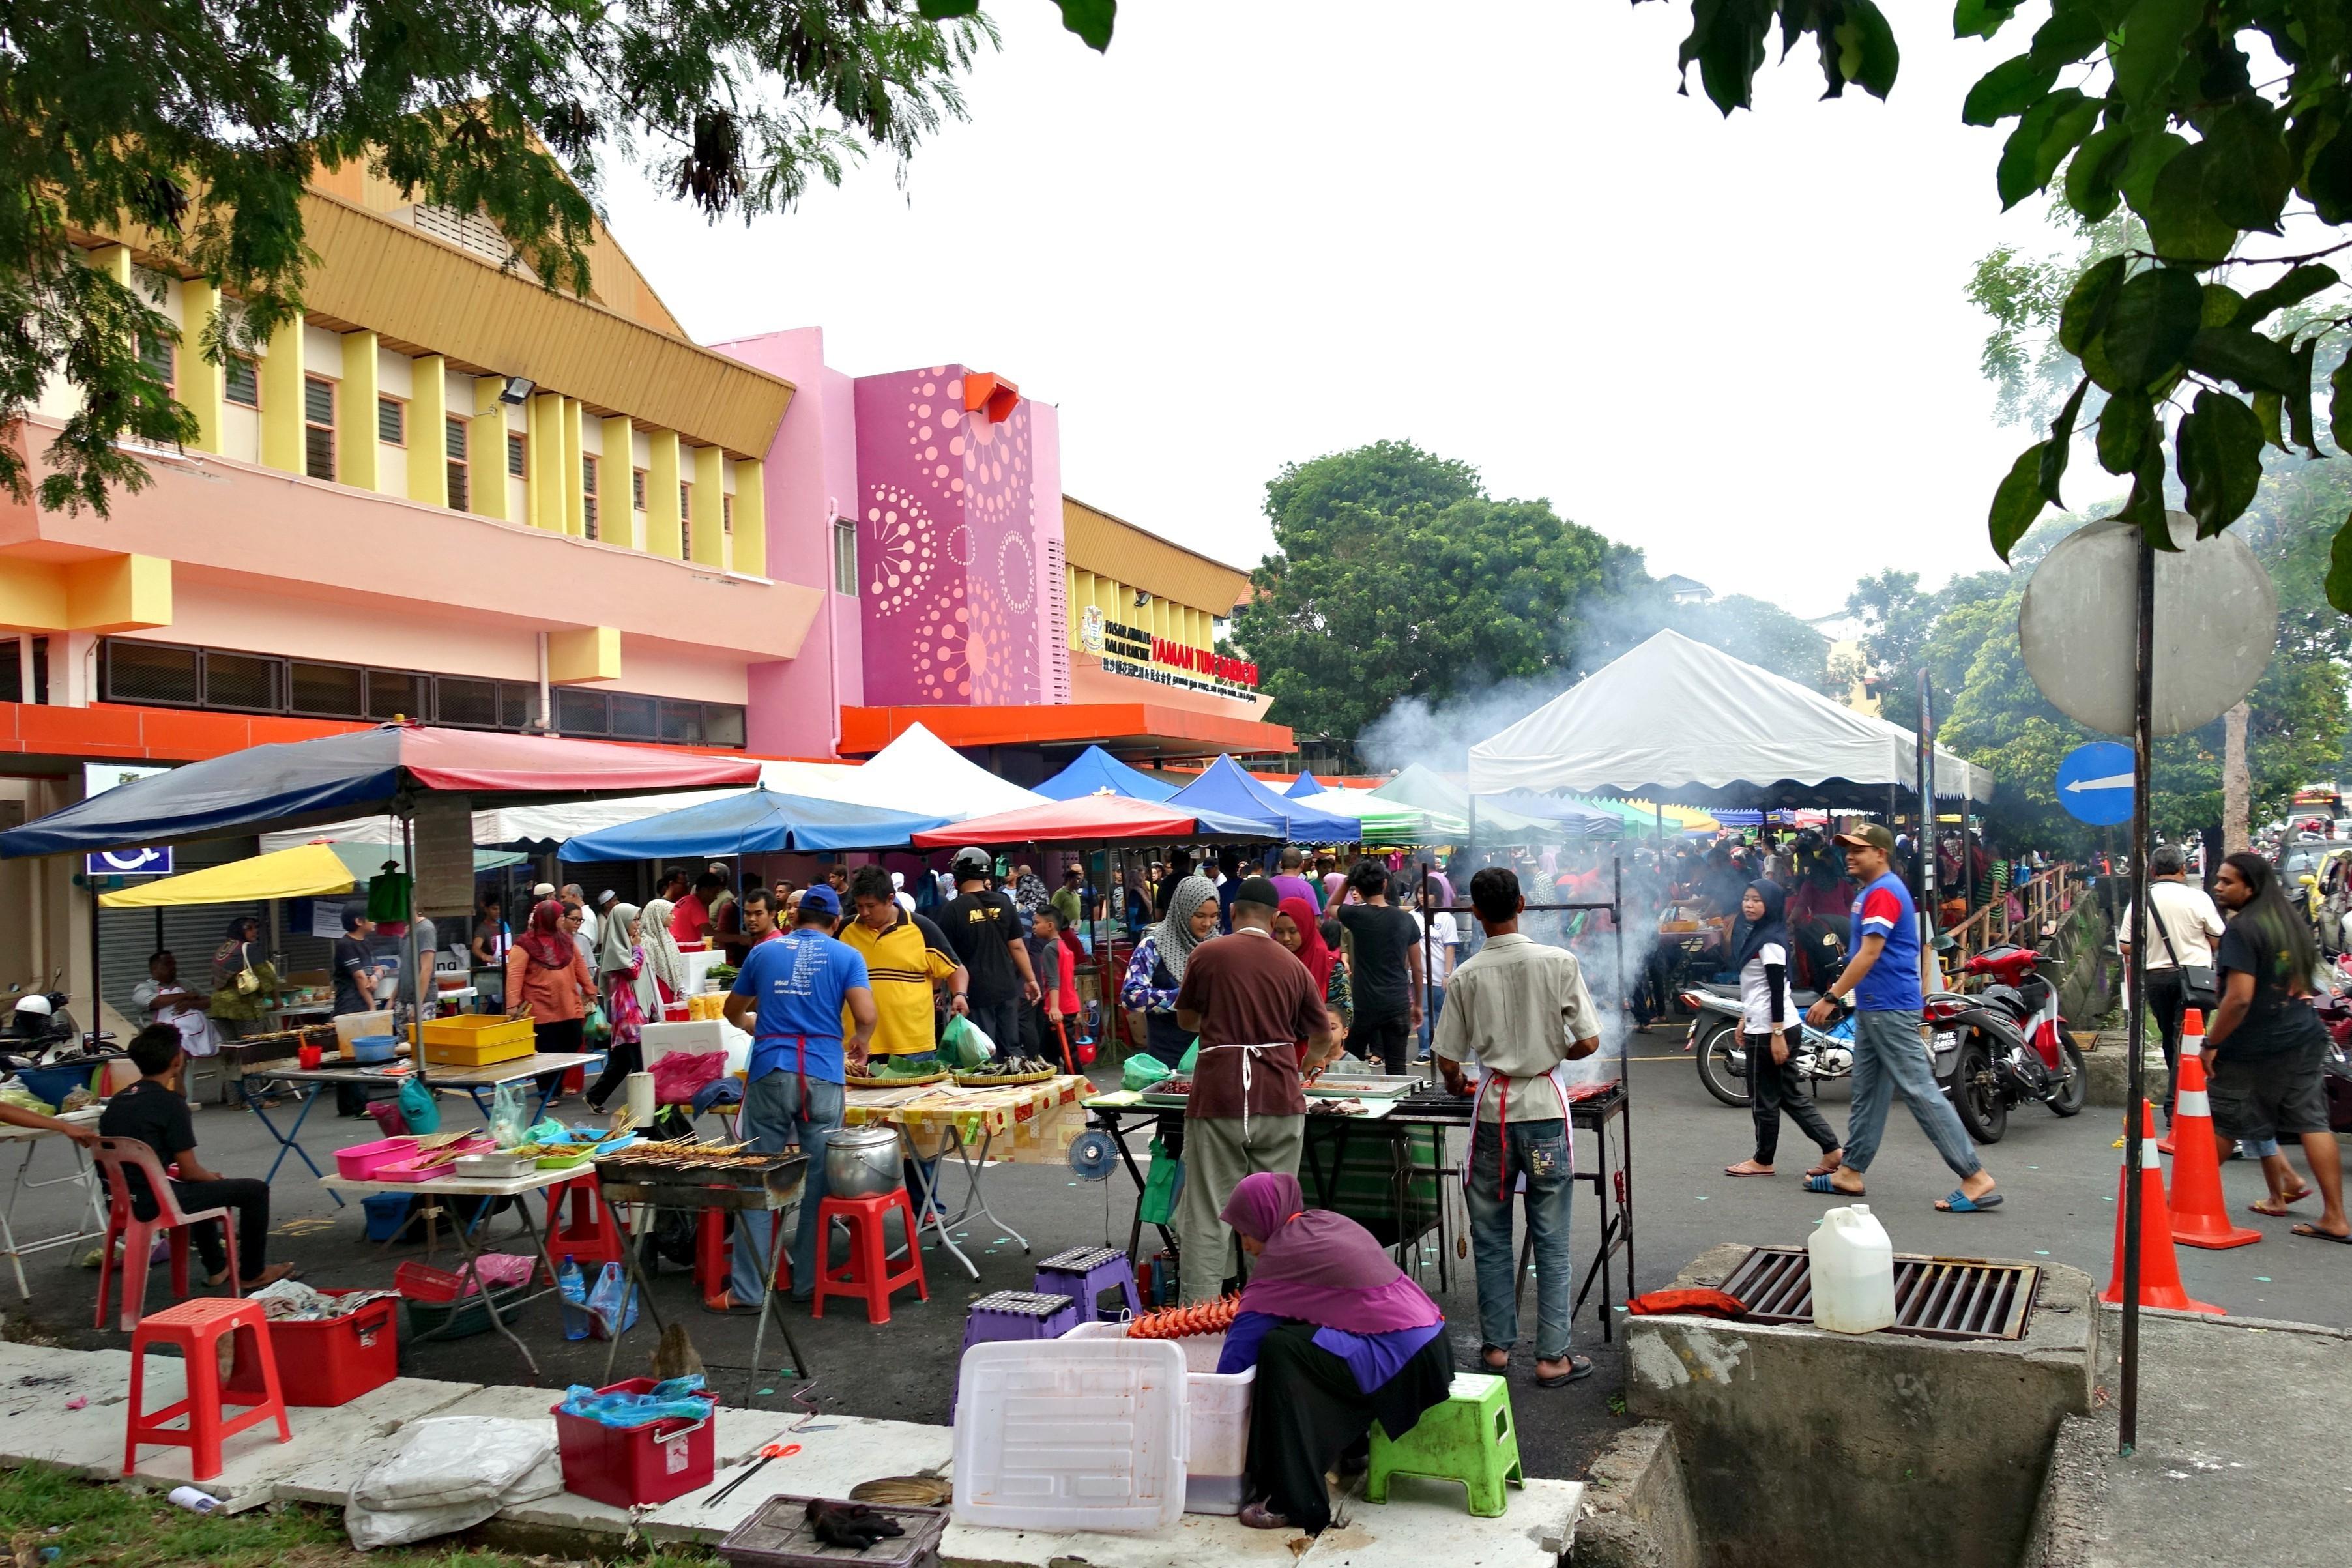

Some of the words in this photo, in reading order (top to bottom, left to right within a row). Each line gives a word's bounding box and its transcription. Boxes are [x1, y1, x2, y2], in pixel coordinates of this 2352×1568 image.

[1105, 620, 1127, 638] PASAR
[1105, 638, 1125, 656] BALAI
[1152, 636, 1193, 670] TAMAN
[1196, 648, 1216, 676] TUN
[1933, 1039, 1956, 1049] 2465
